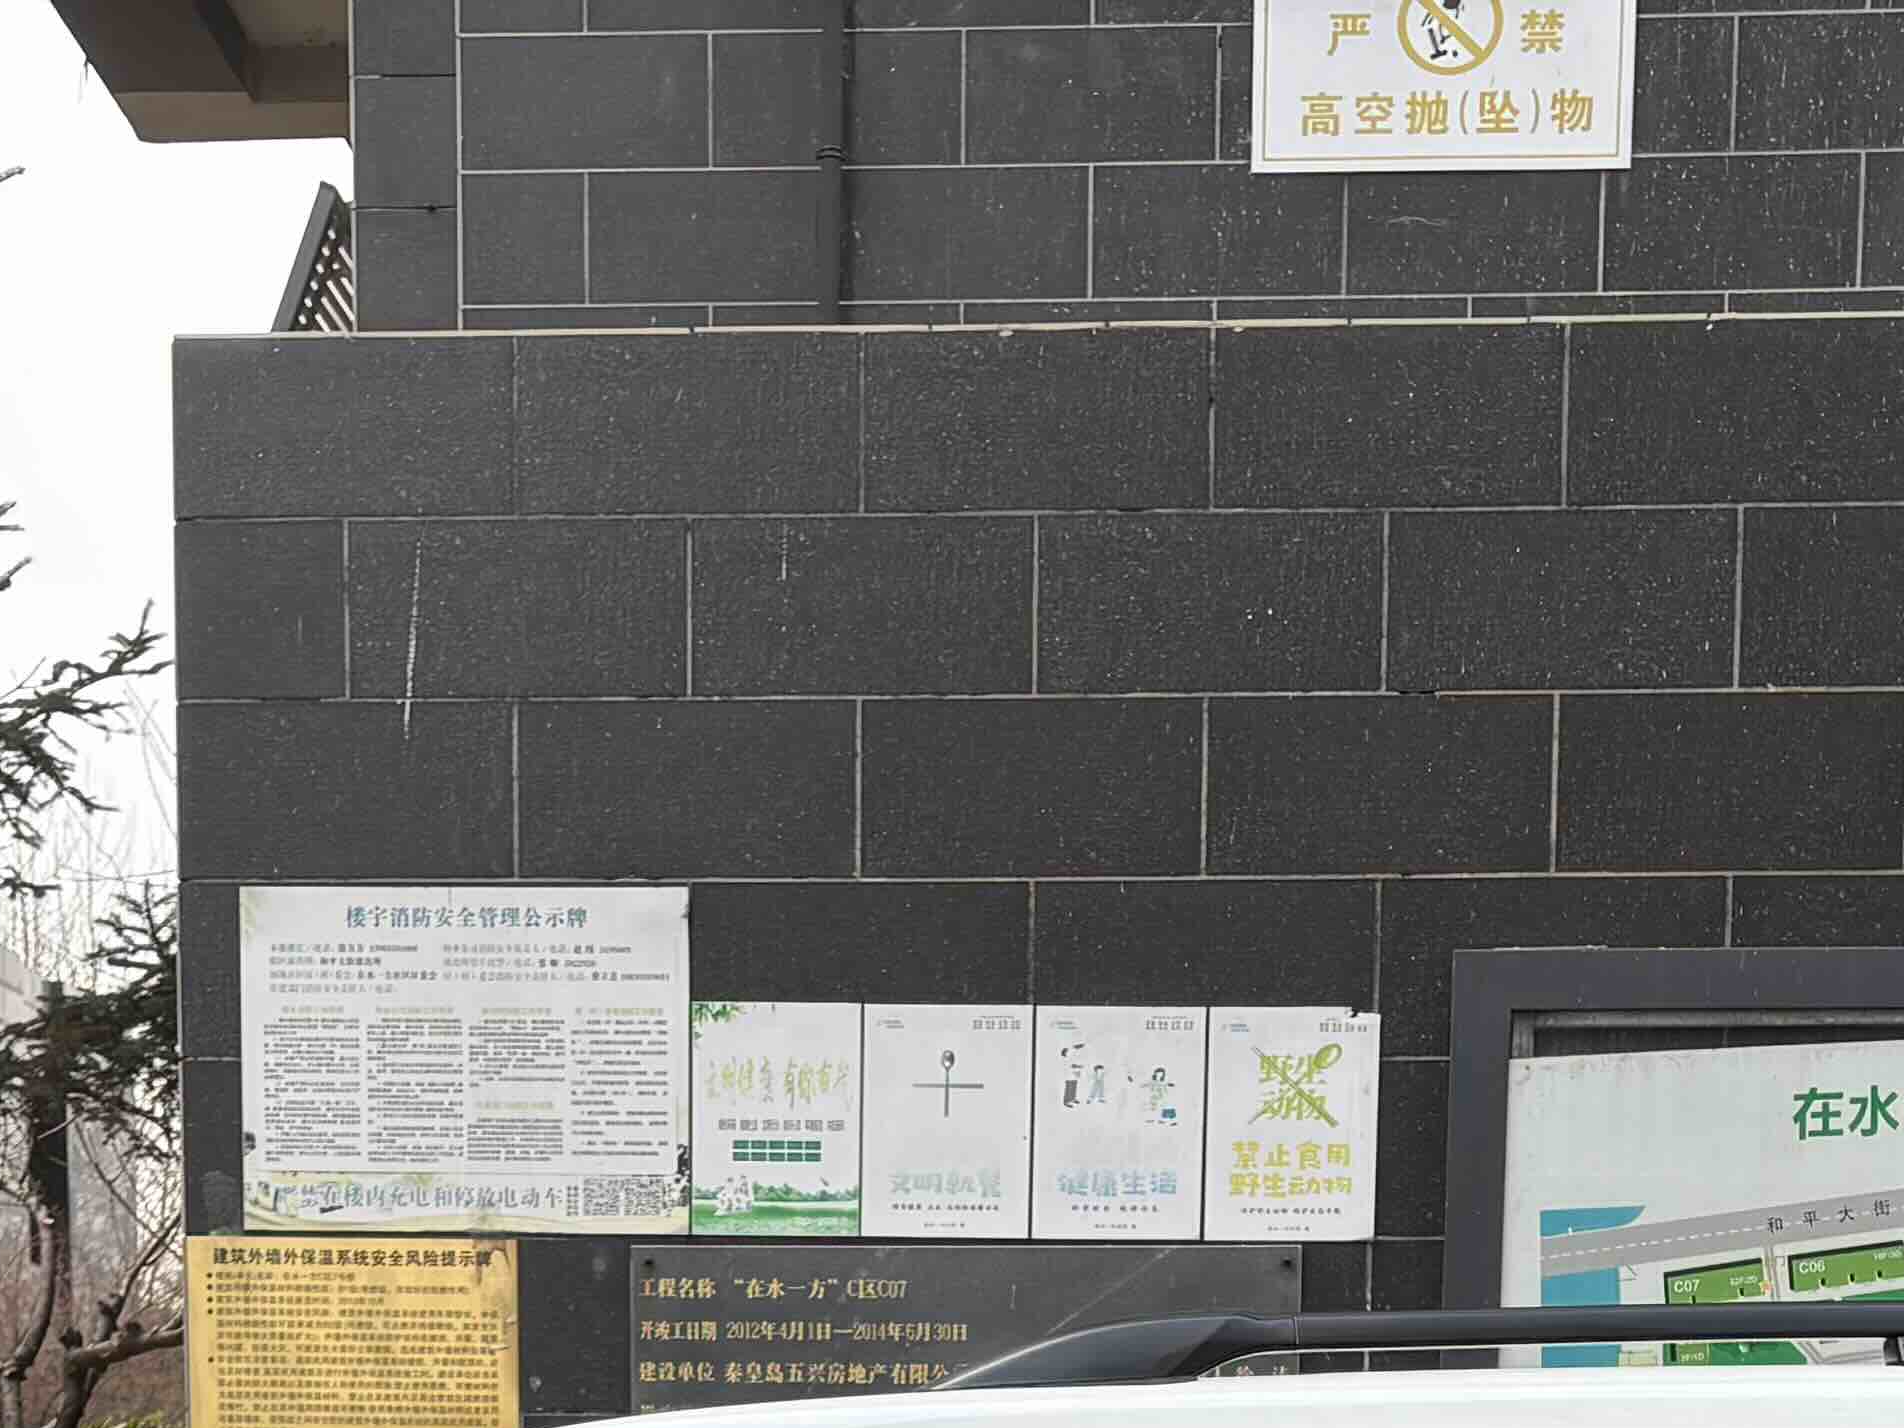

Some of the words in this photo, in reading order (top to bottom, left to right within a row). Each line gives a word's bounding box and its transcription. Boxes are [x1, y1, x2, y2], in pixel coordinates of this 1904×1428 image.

[1327, 13, 1371, 56] 严
[1520, 9, 1566, 54] 禁
[345, 904, 588, 930] 楼宇消防安全管理公示牌
[1231, 1140, 1351, 1169] 禁止食用
[1228, 1172, 1353, 1198] 野生动物
[1767, 1199, 1891, 1233] 和平大街
[1798, 1261, 1826, 1274] C06
[639, 1278, 717, 1299] 工程名称
[1673, 1279, 1701, 1294] C07
[639, 1320, 718, 1343] 开竣工日期
[639, 1361, 716, 1384] 建设单位
[723, 1360, 970, 1386] 秦皇岛五兴房地产有限公
